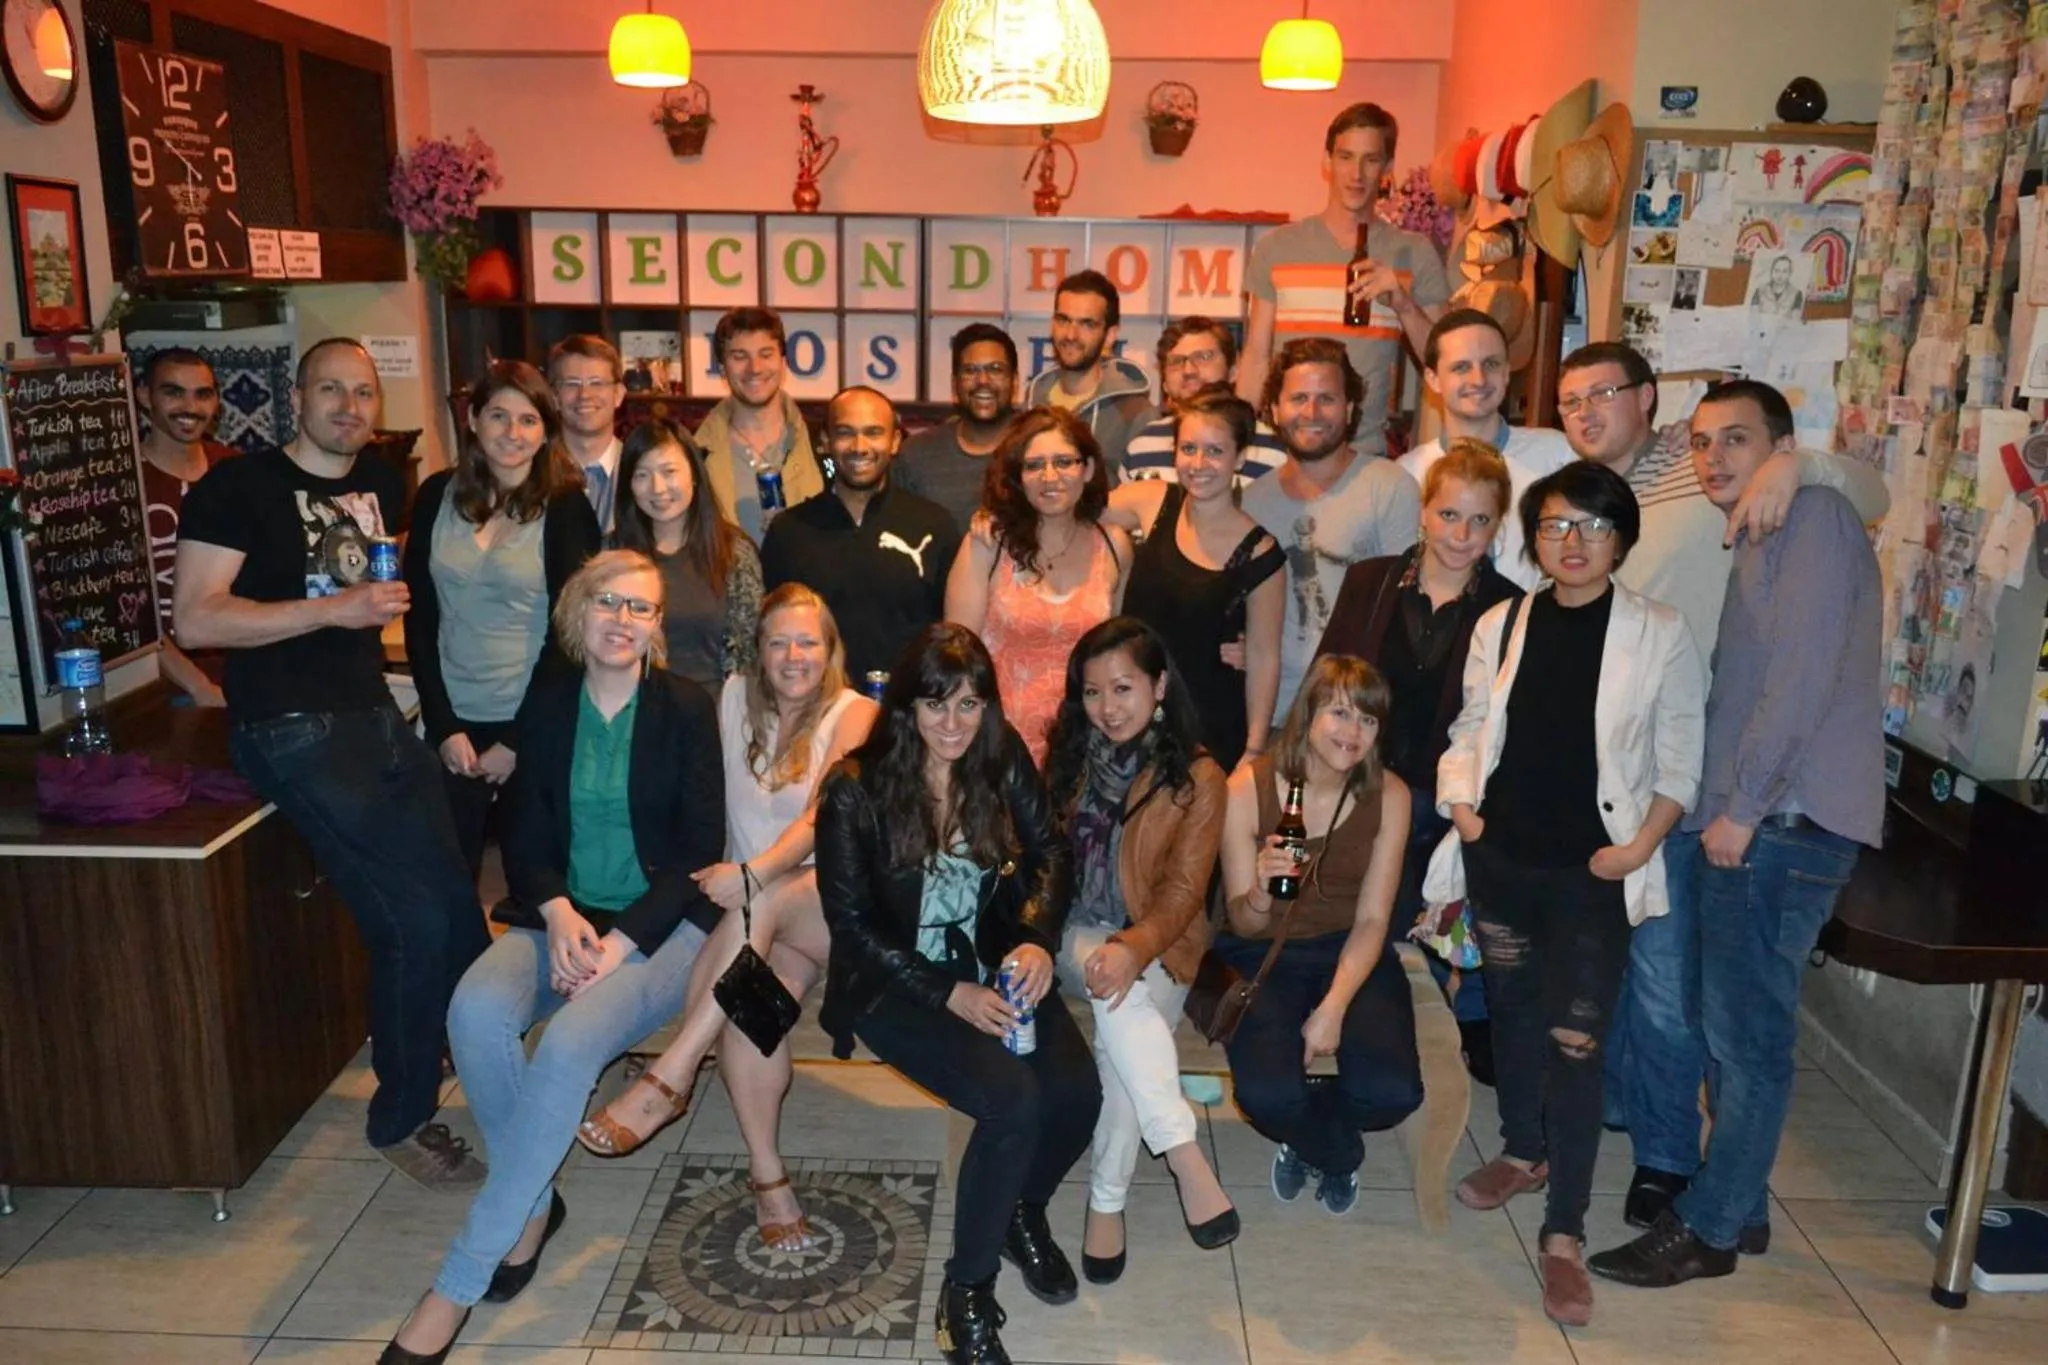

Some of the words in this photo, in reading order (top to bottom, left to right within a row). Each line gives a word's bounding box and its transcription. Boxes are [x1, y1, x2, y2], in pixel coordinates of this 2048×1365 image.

[158, 57, 191, 111] 12
[128, 136, 155, 187] 9
[214, 147, 237, 193] 3
[184, 222, 208, 269] 6
[552, 234, 990, 291] SECOND
[16, 378, 56, 402] After
[27, 412, 74, 437] Turkish
[79, 412, 103, 430] tea
[30, 440, 70, 465] Apple
[33, 465, 85, 491] Orange
[88, 457, 115, 477] tea
[93, 481, 119, 505] tea
